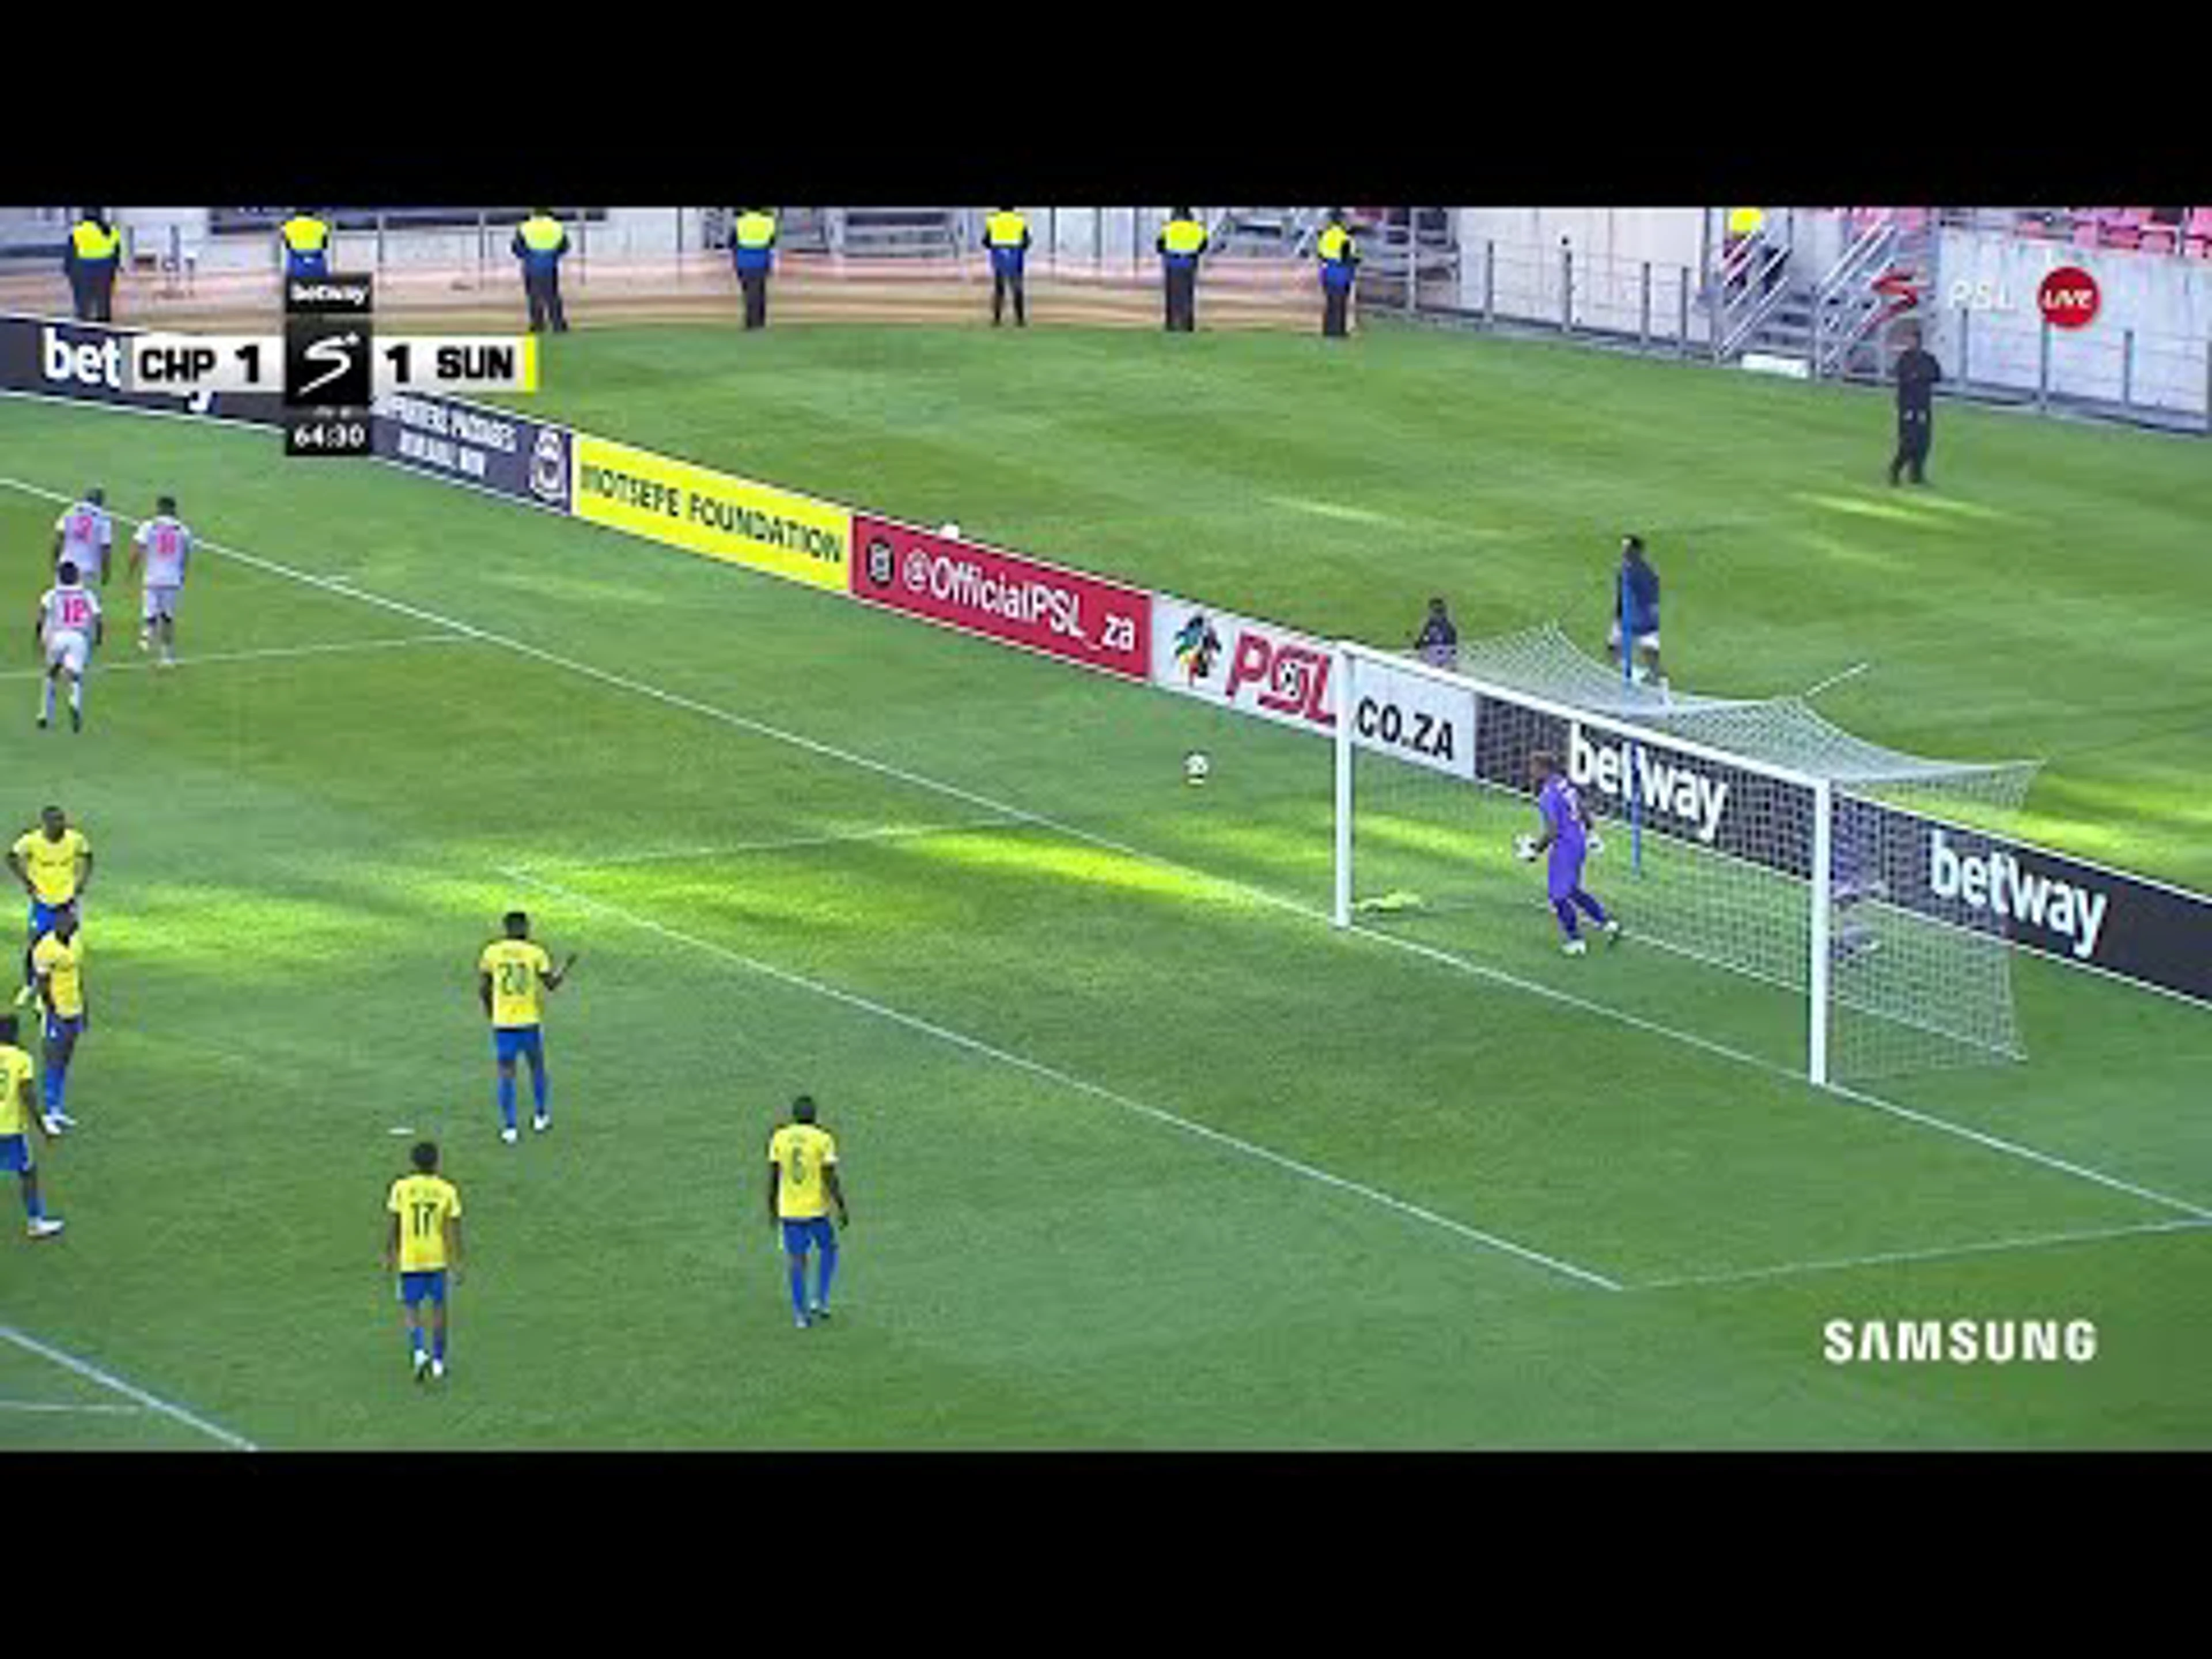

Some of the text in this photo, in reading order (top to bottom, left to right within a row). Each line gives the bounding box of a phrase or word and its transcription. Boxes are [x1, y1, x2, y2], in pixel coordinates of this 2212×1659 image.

[690, 492, 843, 562] FOUNDATION
[904, 547, 1135, 650] @OfficialPSL_za
[1226, 632, 1336, 727] PSL
[1932, 830, 2107, 957] betway
